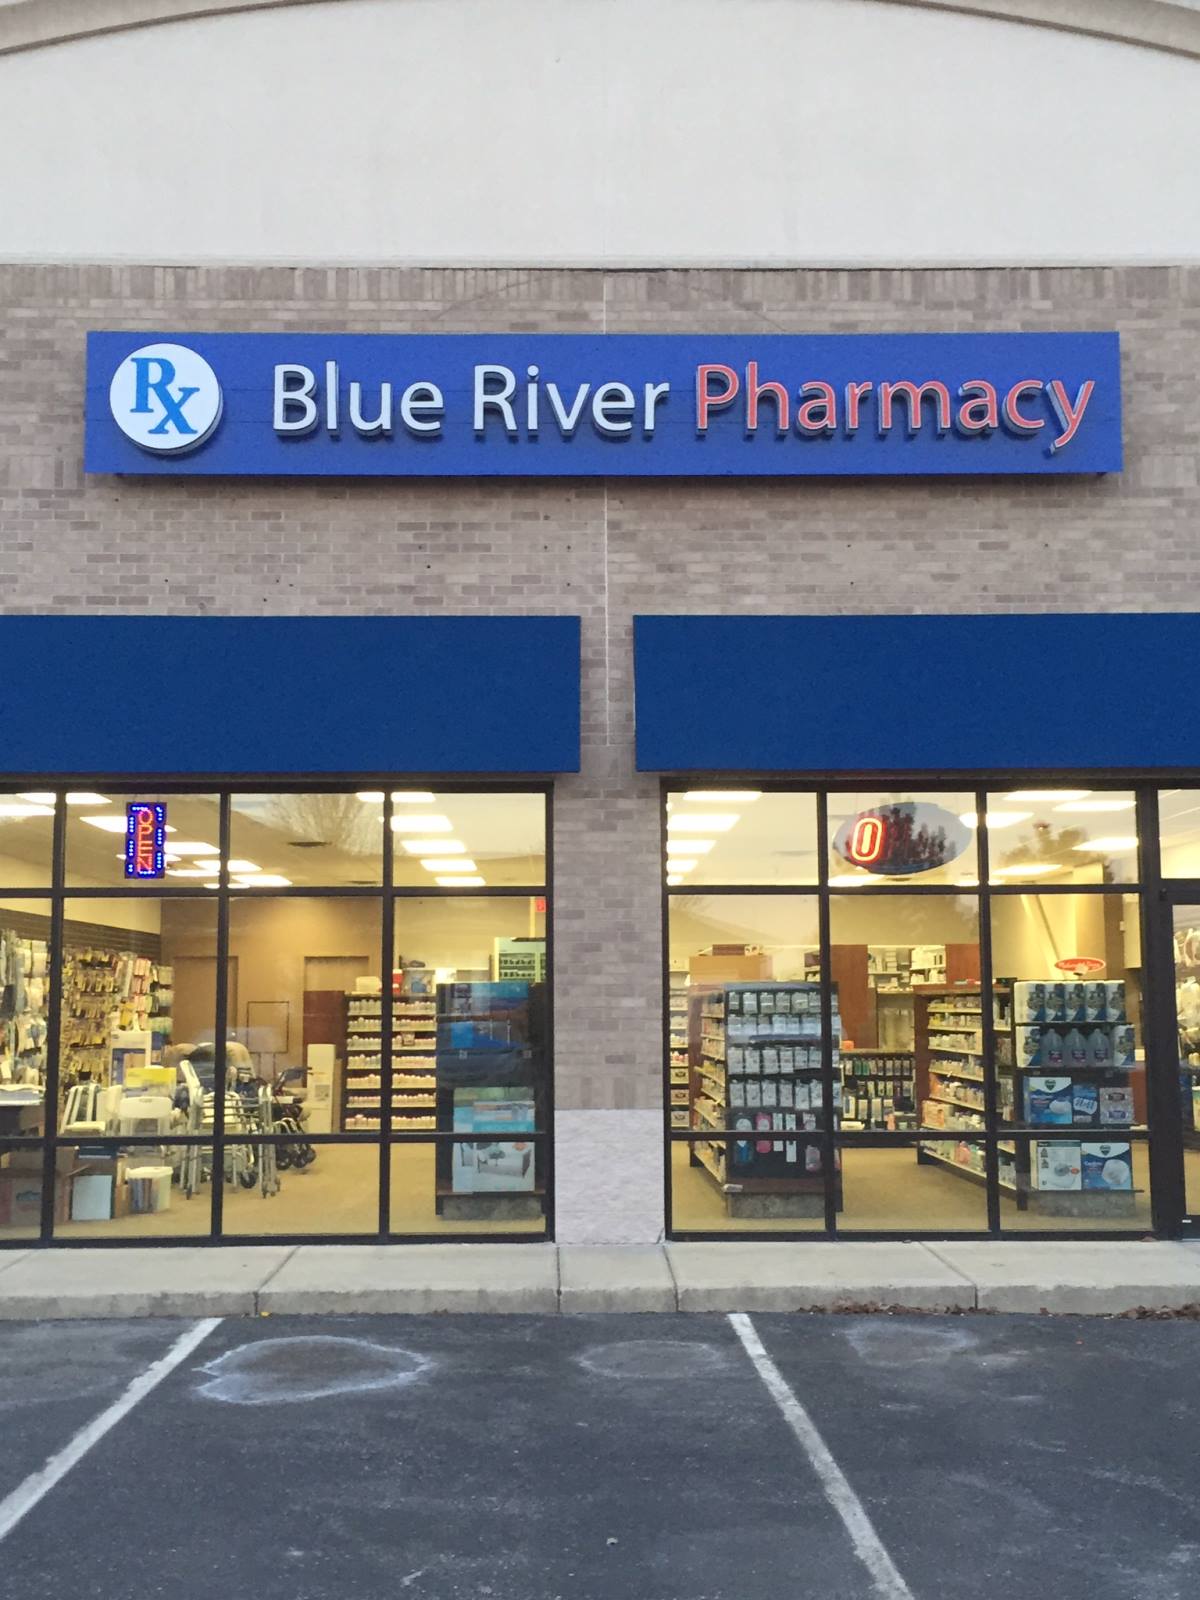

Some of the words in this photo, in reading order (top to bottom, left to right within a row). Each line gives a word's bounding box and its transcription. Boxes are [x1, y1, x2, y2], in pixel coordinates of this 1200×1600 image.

[272, 360, 445, 435] Blue
[473, 364, 670, 435] River
[696, 360, 1095, 450] Pharmacy
[136, 808, 153, 874] OPEN
